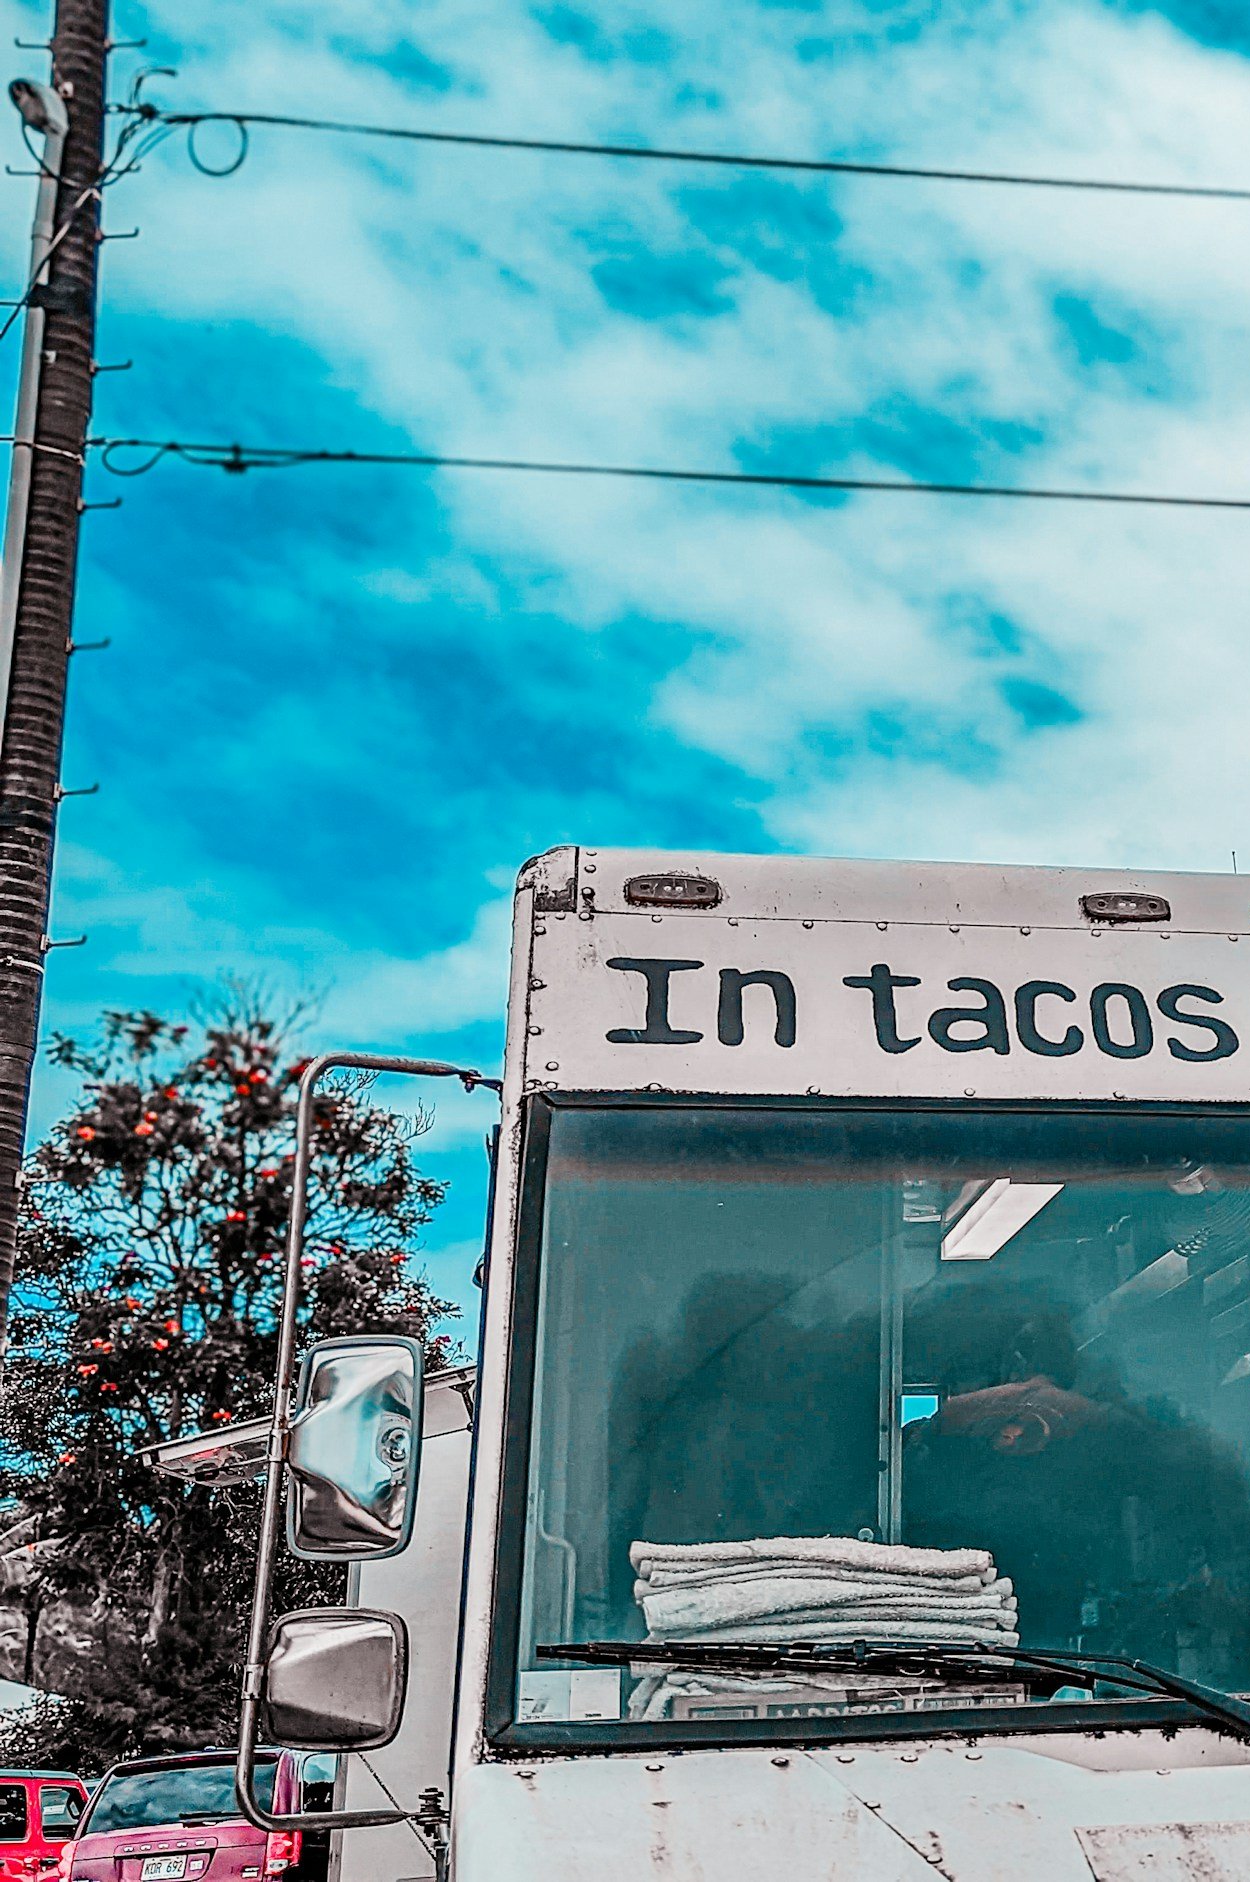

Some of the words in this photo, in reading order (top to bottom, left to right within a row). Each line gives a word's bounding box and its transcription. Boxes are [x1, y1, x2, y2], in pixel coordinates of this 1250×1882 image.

[604, 956, 797, 1049] In
[842, 963, 1240, 1063] tacos
[166, 1860, 184, 1873] 692
